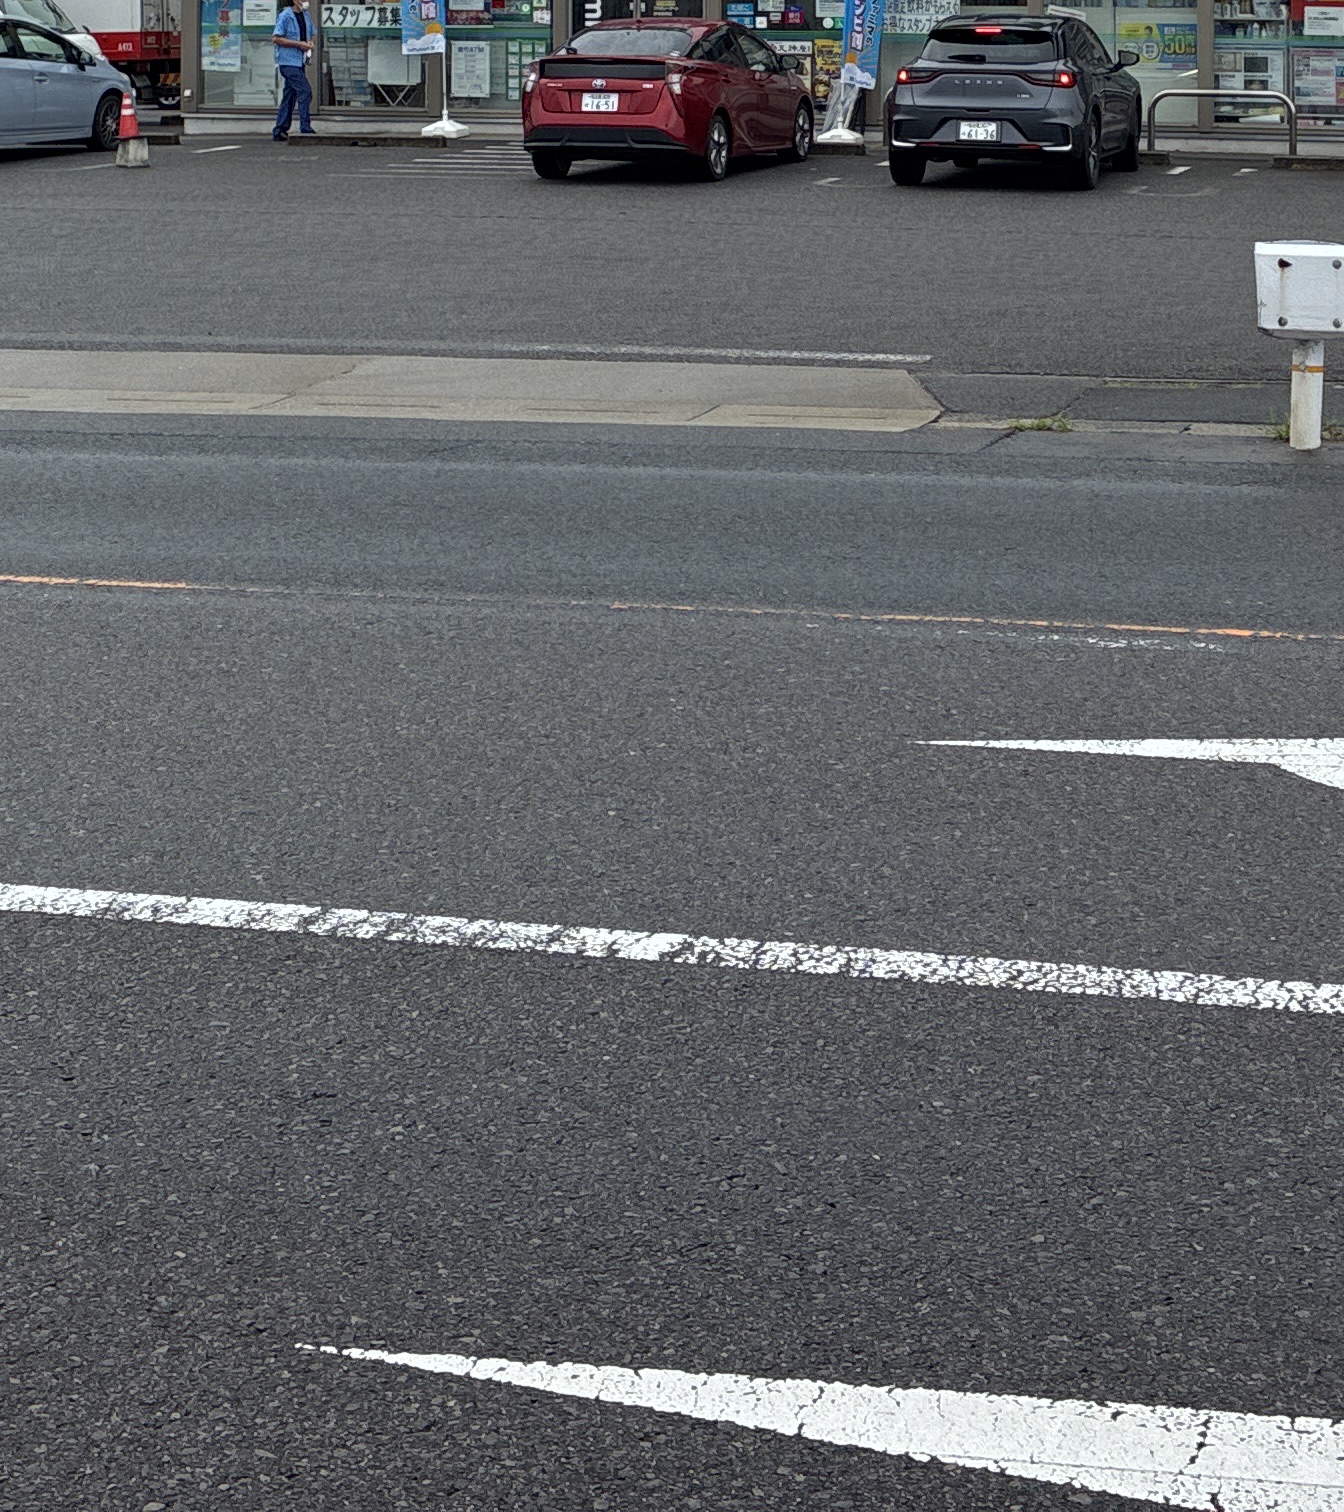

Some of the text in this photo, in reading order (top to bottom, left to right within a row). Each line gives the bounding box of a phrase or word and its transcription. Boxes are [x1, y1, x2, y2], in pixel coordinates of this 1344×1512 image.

[323, 5, 402, 26] スタッフ募集
[590, 99, 616, 110] 16-51
[967, 128, 996, 140] 61-36
